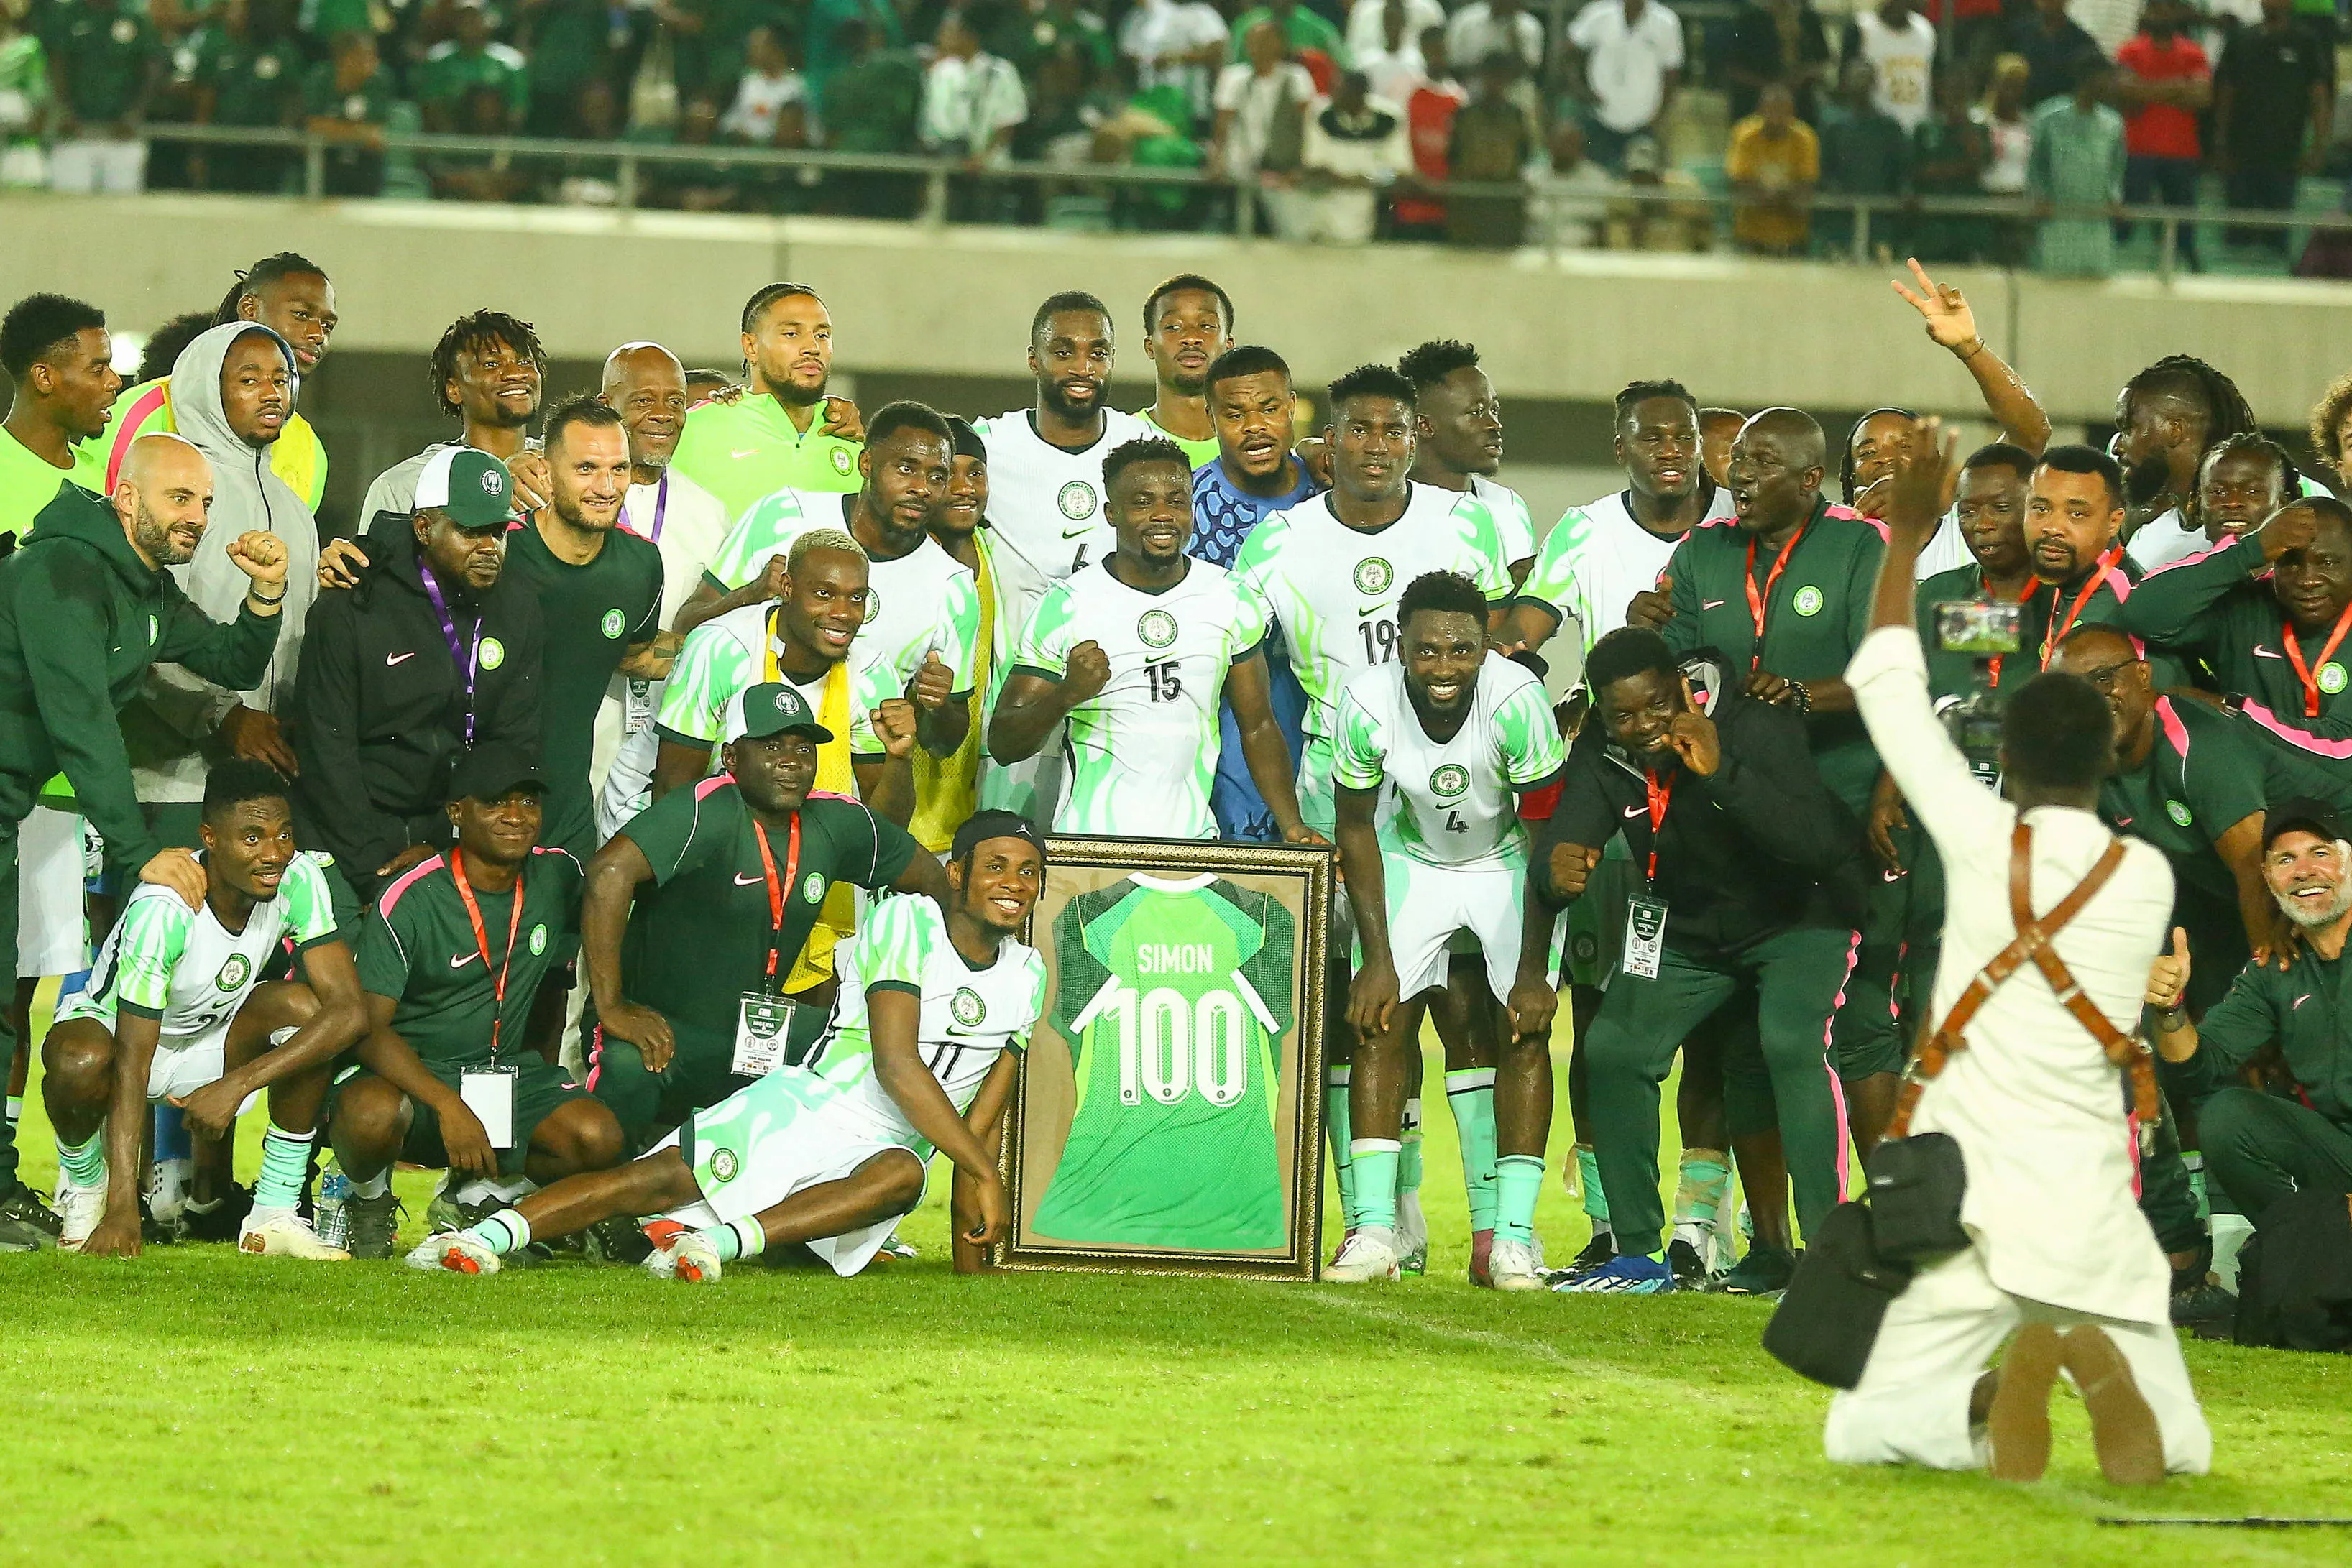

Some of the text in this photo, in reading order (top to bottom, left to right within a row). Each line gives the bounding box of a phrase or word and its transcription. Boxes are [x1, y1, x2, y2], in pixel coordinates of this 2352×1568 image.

[1071, 543, 1089, 575] 6
[1358, 619, 1397, 666] 19
[1144, 661, 1182, 703] 15
[1446, 811, 1469, 834] 4
[1138, 944, 1213, 973] SIMON
[1104, 987, 1248, 1107] 100
